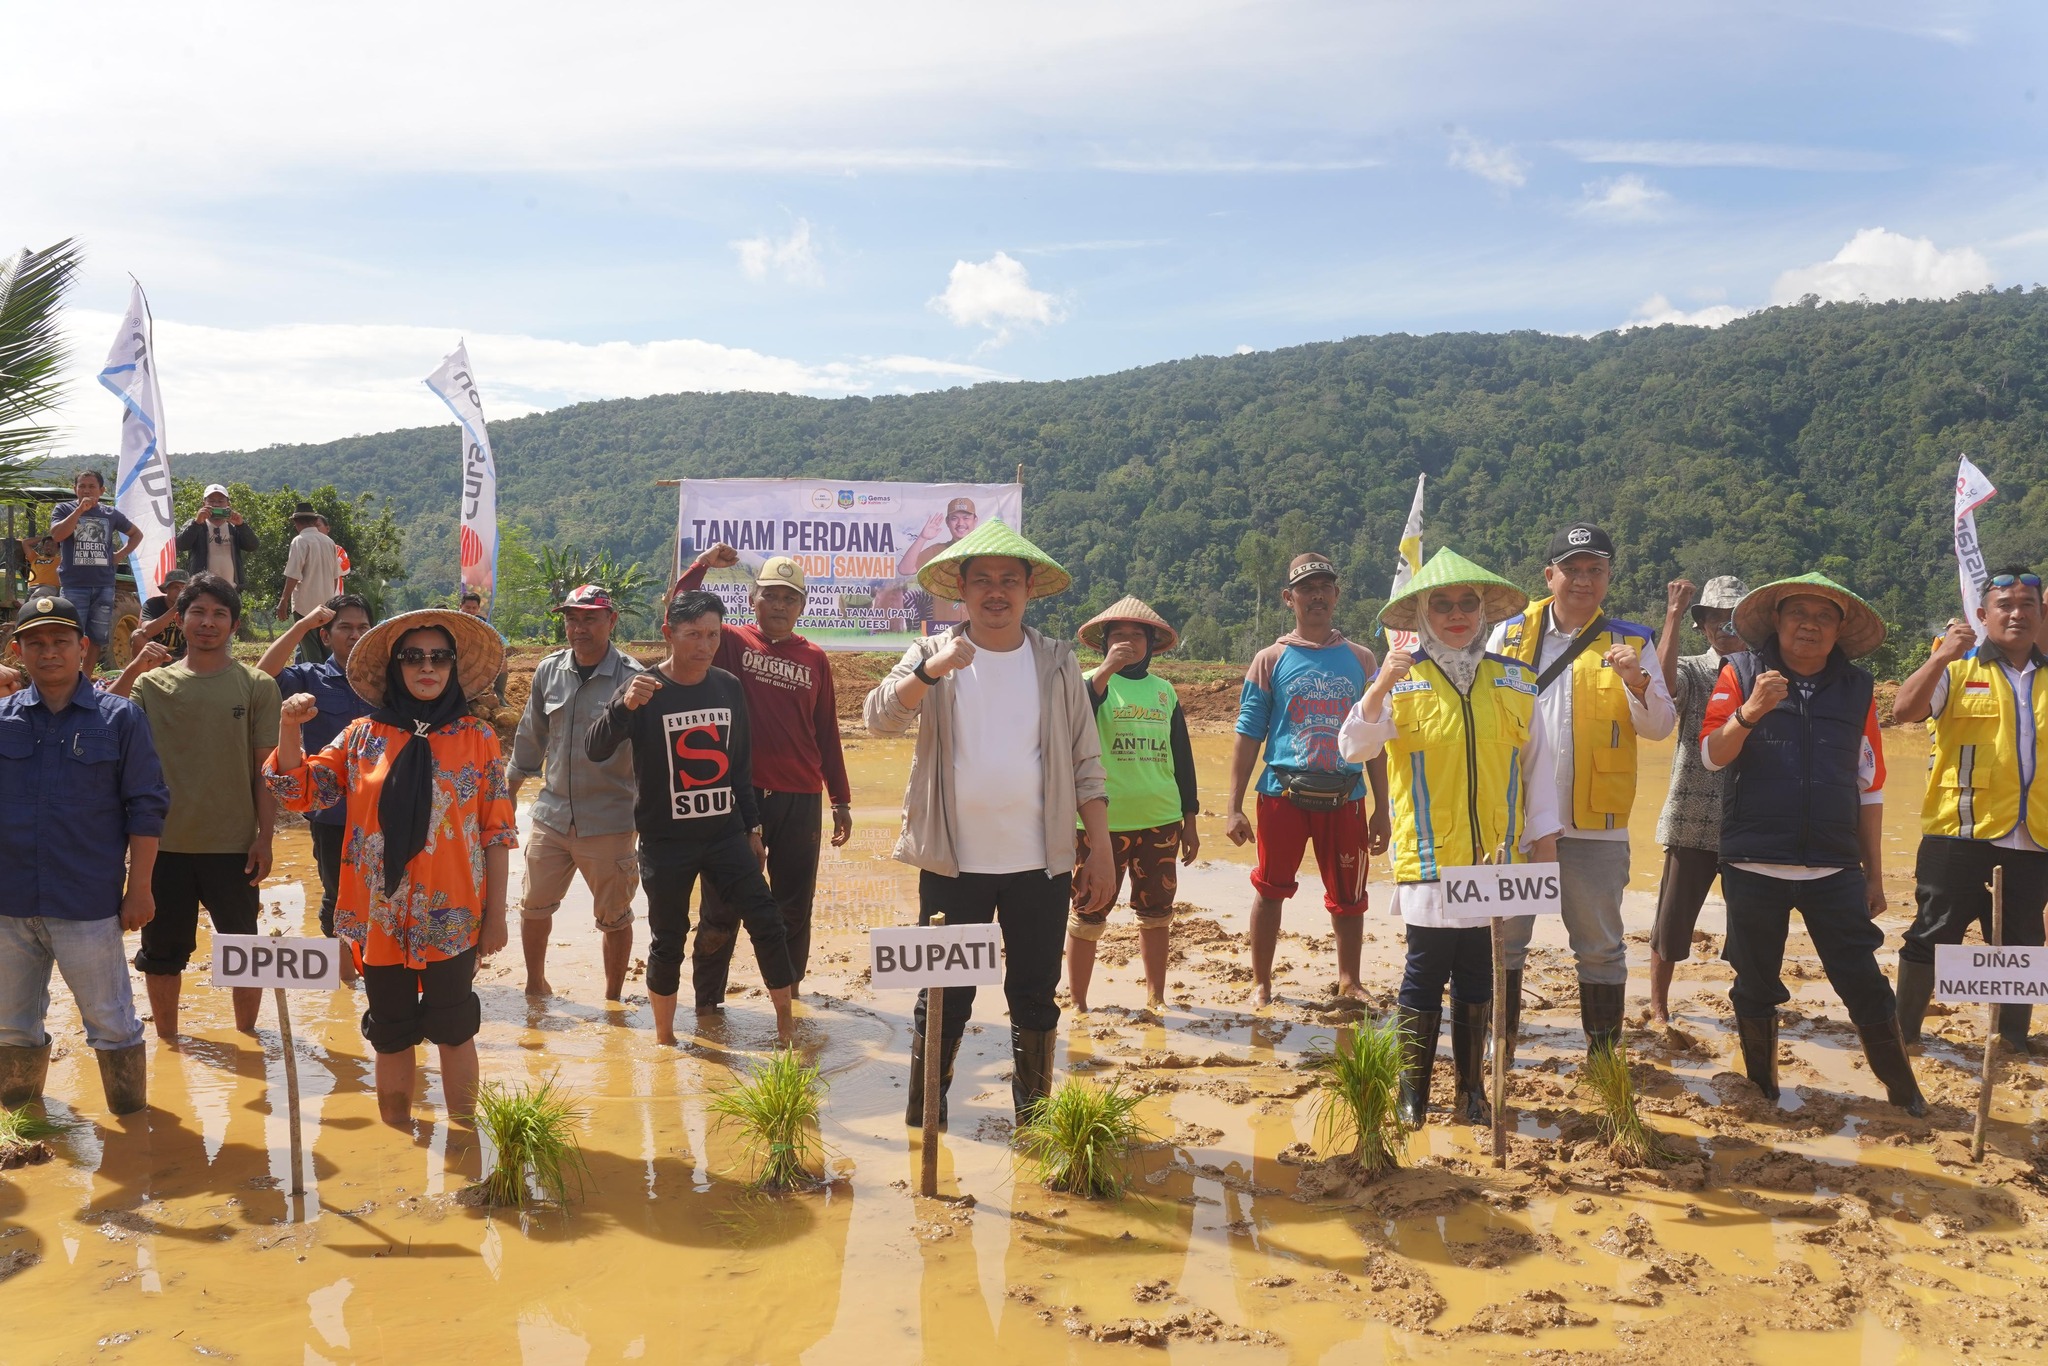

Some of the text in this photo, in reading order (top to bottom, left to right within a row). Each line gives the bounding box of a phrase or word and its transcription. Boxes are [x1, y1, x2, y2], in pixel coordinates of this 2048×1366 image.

[692, 520, 895, 553] TANAM PERDANA
[792, 555, 895, 578] PADI SAWAH
[1293, 562, 1330, 576] GUCCI
[700, 583, 730, 592] ALAM
[808, 596, 833, 605] PADI
[808, 608, 916, 620] AREAL TANAM (PAT)
[796, 619, 890, 630] ECAMATAN UEESI
[742, 650, 813, 686] ORIGINAL
[772, 680, 797, 691] QUALITY
[1288, 695, 1352, 724] STORIES
[667, 711, 730, 728] EVERYONE
[1325, 717, 1339, 727] END
[1112, 737, 1167, 752] ANTILA
[675, 722, 729, 790] S
[1446, 876, 1559, 904] KA. BWS
[222, 945, 329, 980] DPRD
[875, 941, 996, 973] BUPATI
[1973, 952, 2031, 969] DINAS
[1939, 979, 2048, 997] NAKERTRAN
